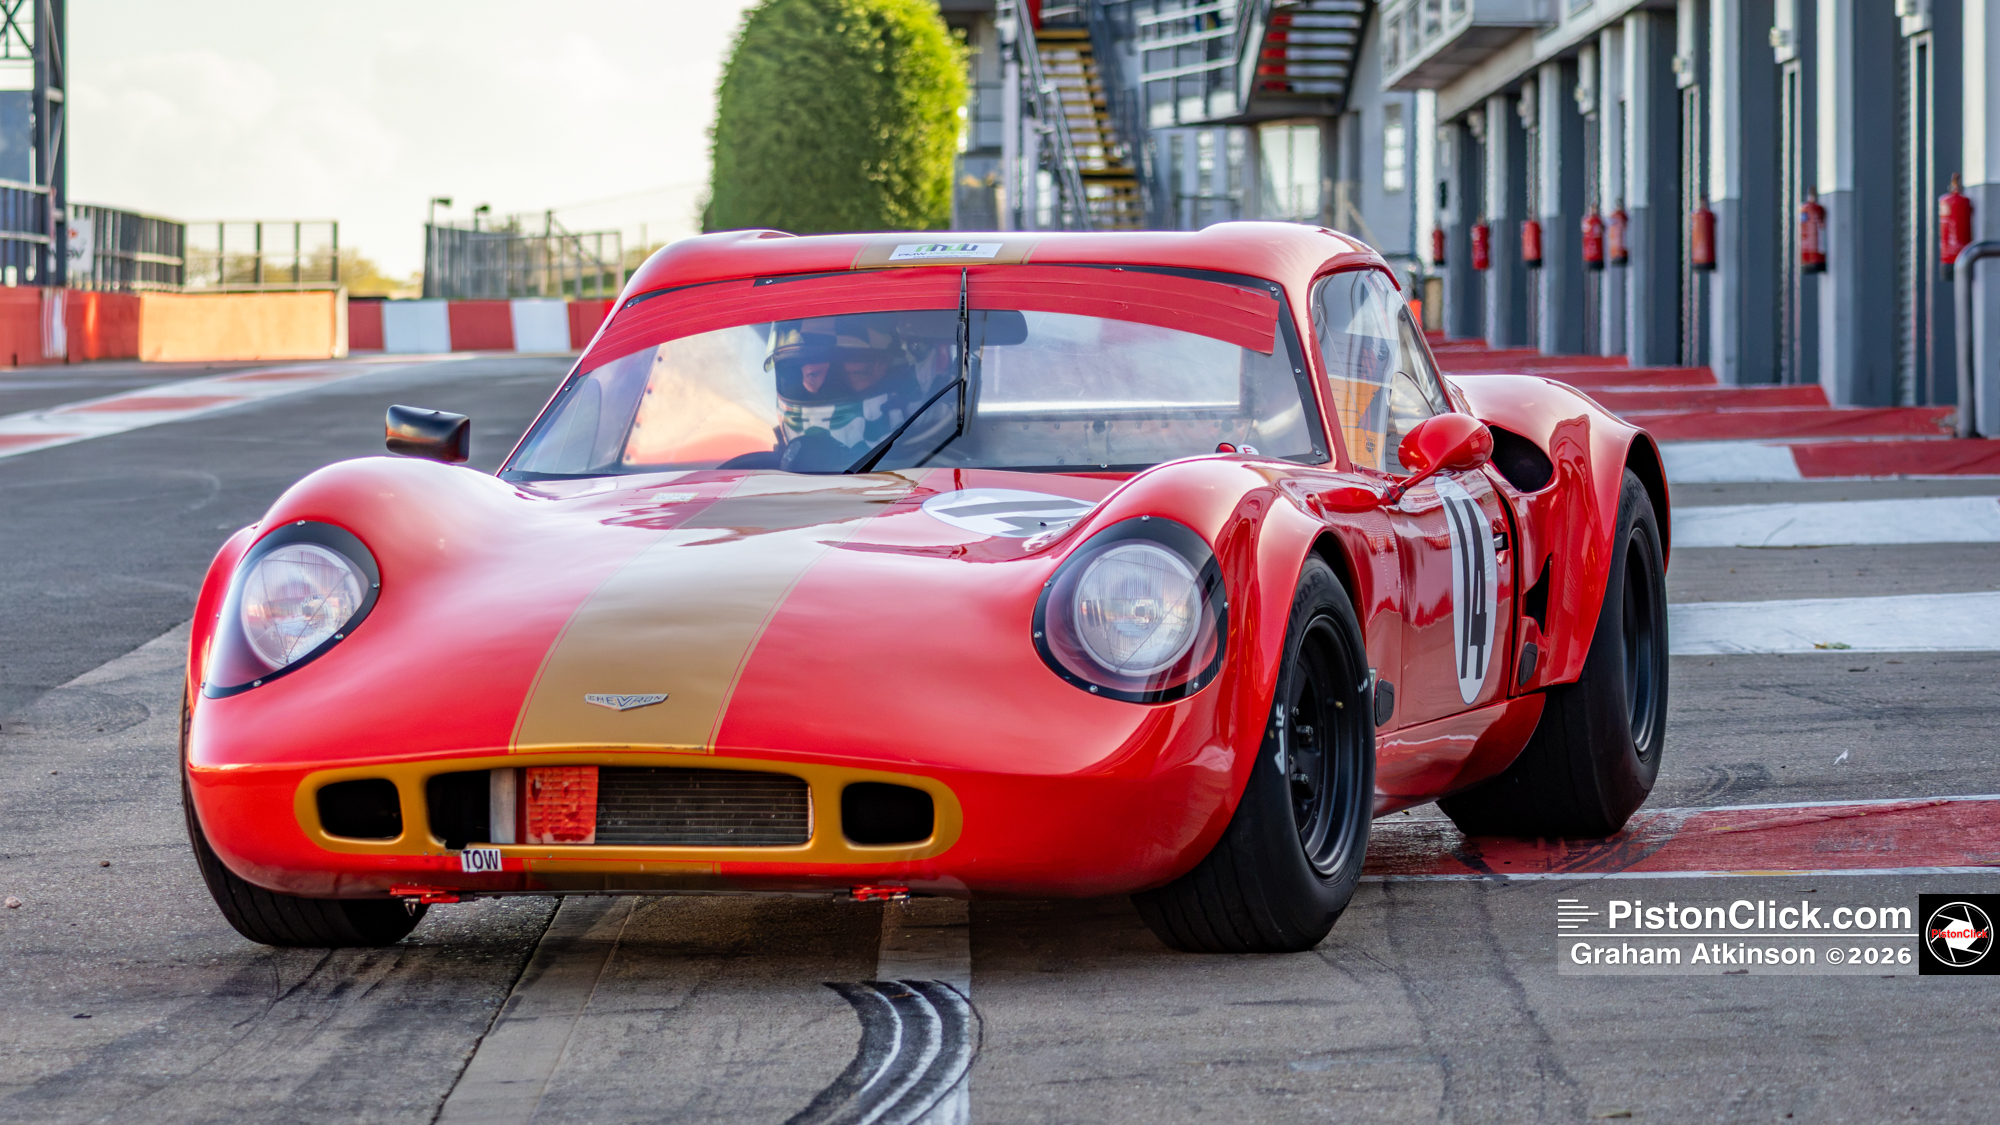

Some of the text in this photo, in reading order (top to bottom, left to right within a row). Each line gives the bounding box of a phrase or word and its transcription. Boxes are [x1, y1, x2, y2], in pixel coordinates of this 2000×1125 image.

[1443, 496, 1487, 680] 14
[588, 696, 662, 707] CHEVRON
[463, 850, 498, 869] TOW
